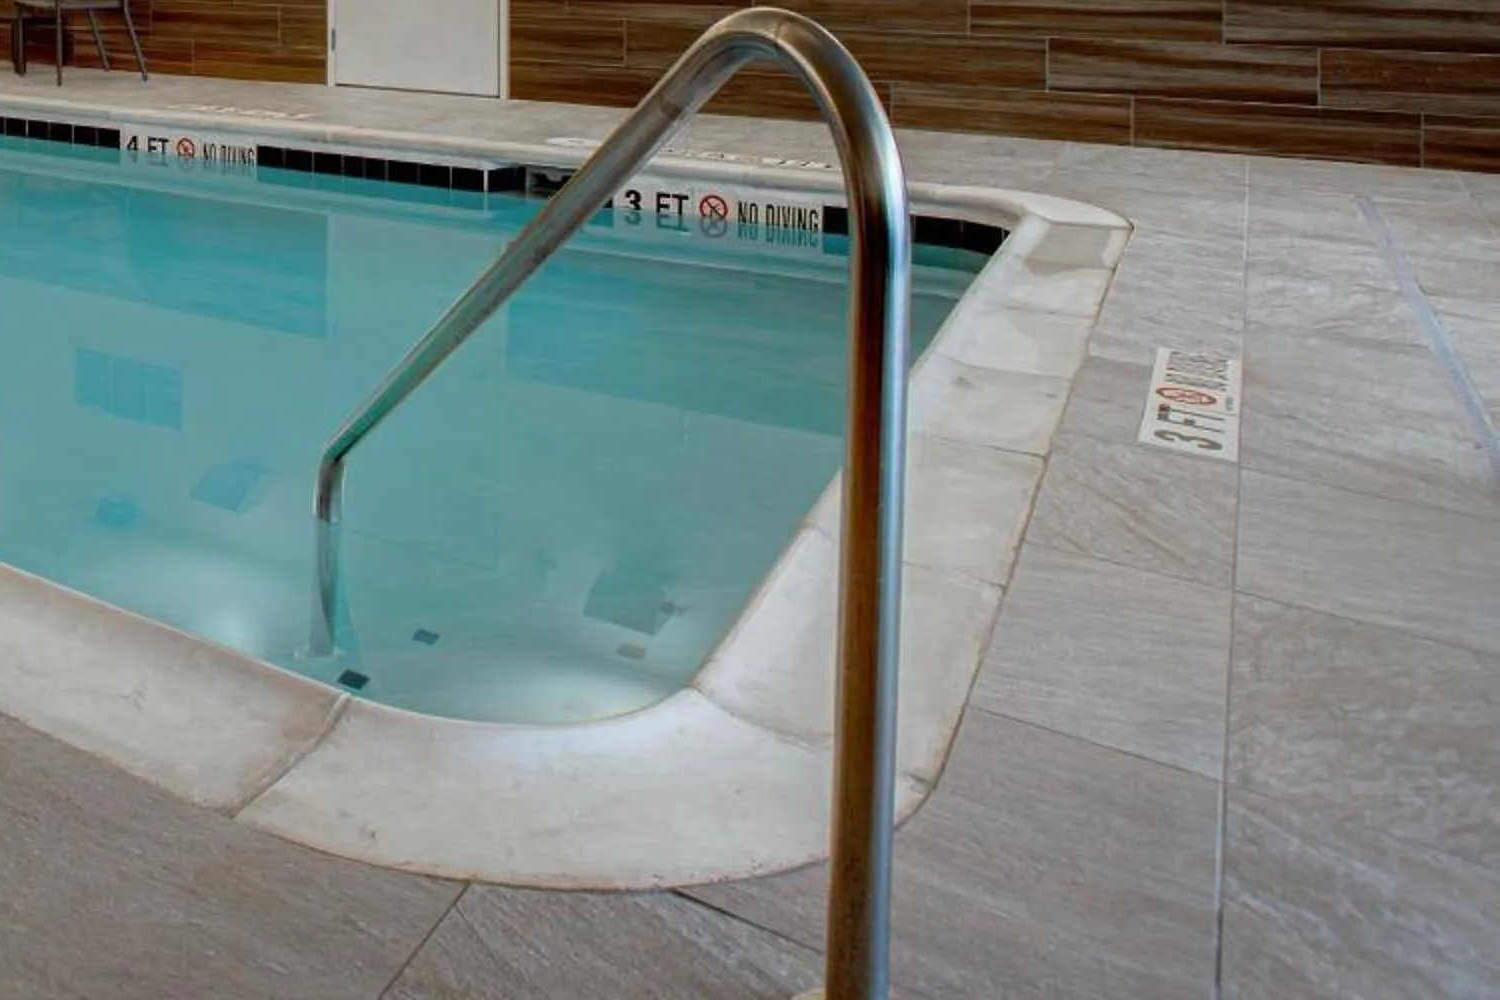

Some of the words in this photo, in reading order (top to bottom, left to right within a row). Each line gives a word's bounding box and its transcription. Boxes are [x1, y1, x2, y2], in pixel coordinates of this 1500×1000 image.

[624, 189, 642, 211] 3
[656, 192, 690, 216] FT
[738, 201, 759, 225] NO
[765, 204, 820, 231] DIVING
